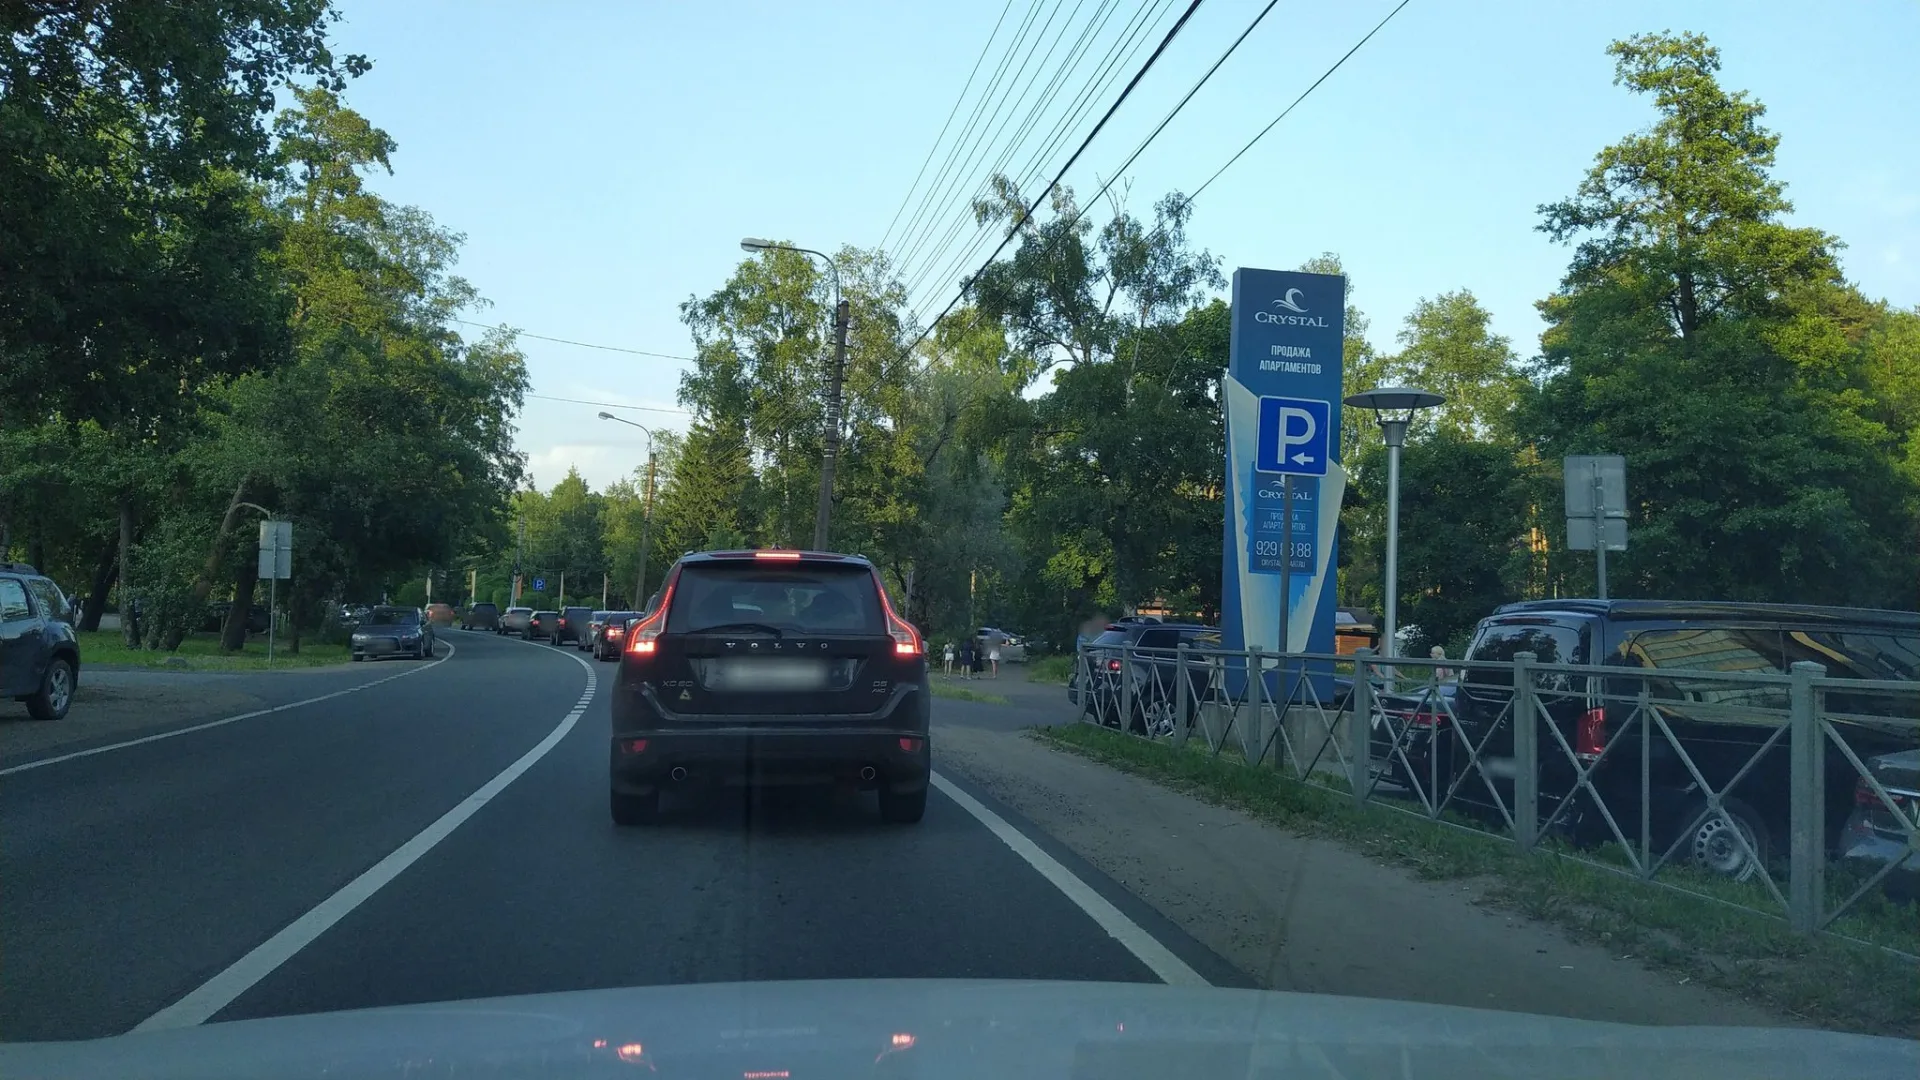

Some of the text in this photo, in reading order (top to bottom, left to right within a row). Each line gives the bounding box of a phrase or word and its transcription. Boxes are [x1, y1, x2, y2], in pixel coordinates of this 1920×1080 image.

[1254, 311, 1329, 328] CRYSTAL
[1271, 344, 1311, 358] ПРОДАЖА
[1259, 359, 1322, 375] АПАРТАМЕНТОВ
[1277, 406, 1316, 464] P
[1258, 489, 1312, 501] CRYTAL
[1270, 511, 1299, 521] ПРОДА
[1262, 521, 1306, 531] АПАРТАНТОВ
[1256, 540, 1277, 556] 929
[1296, 542, 1311, 558] 88
